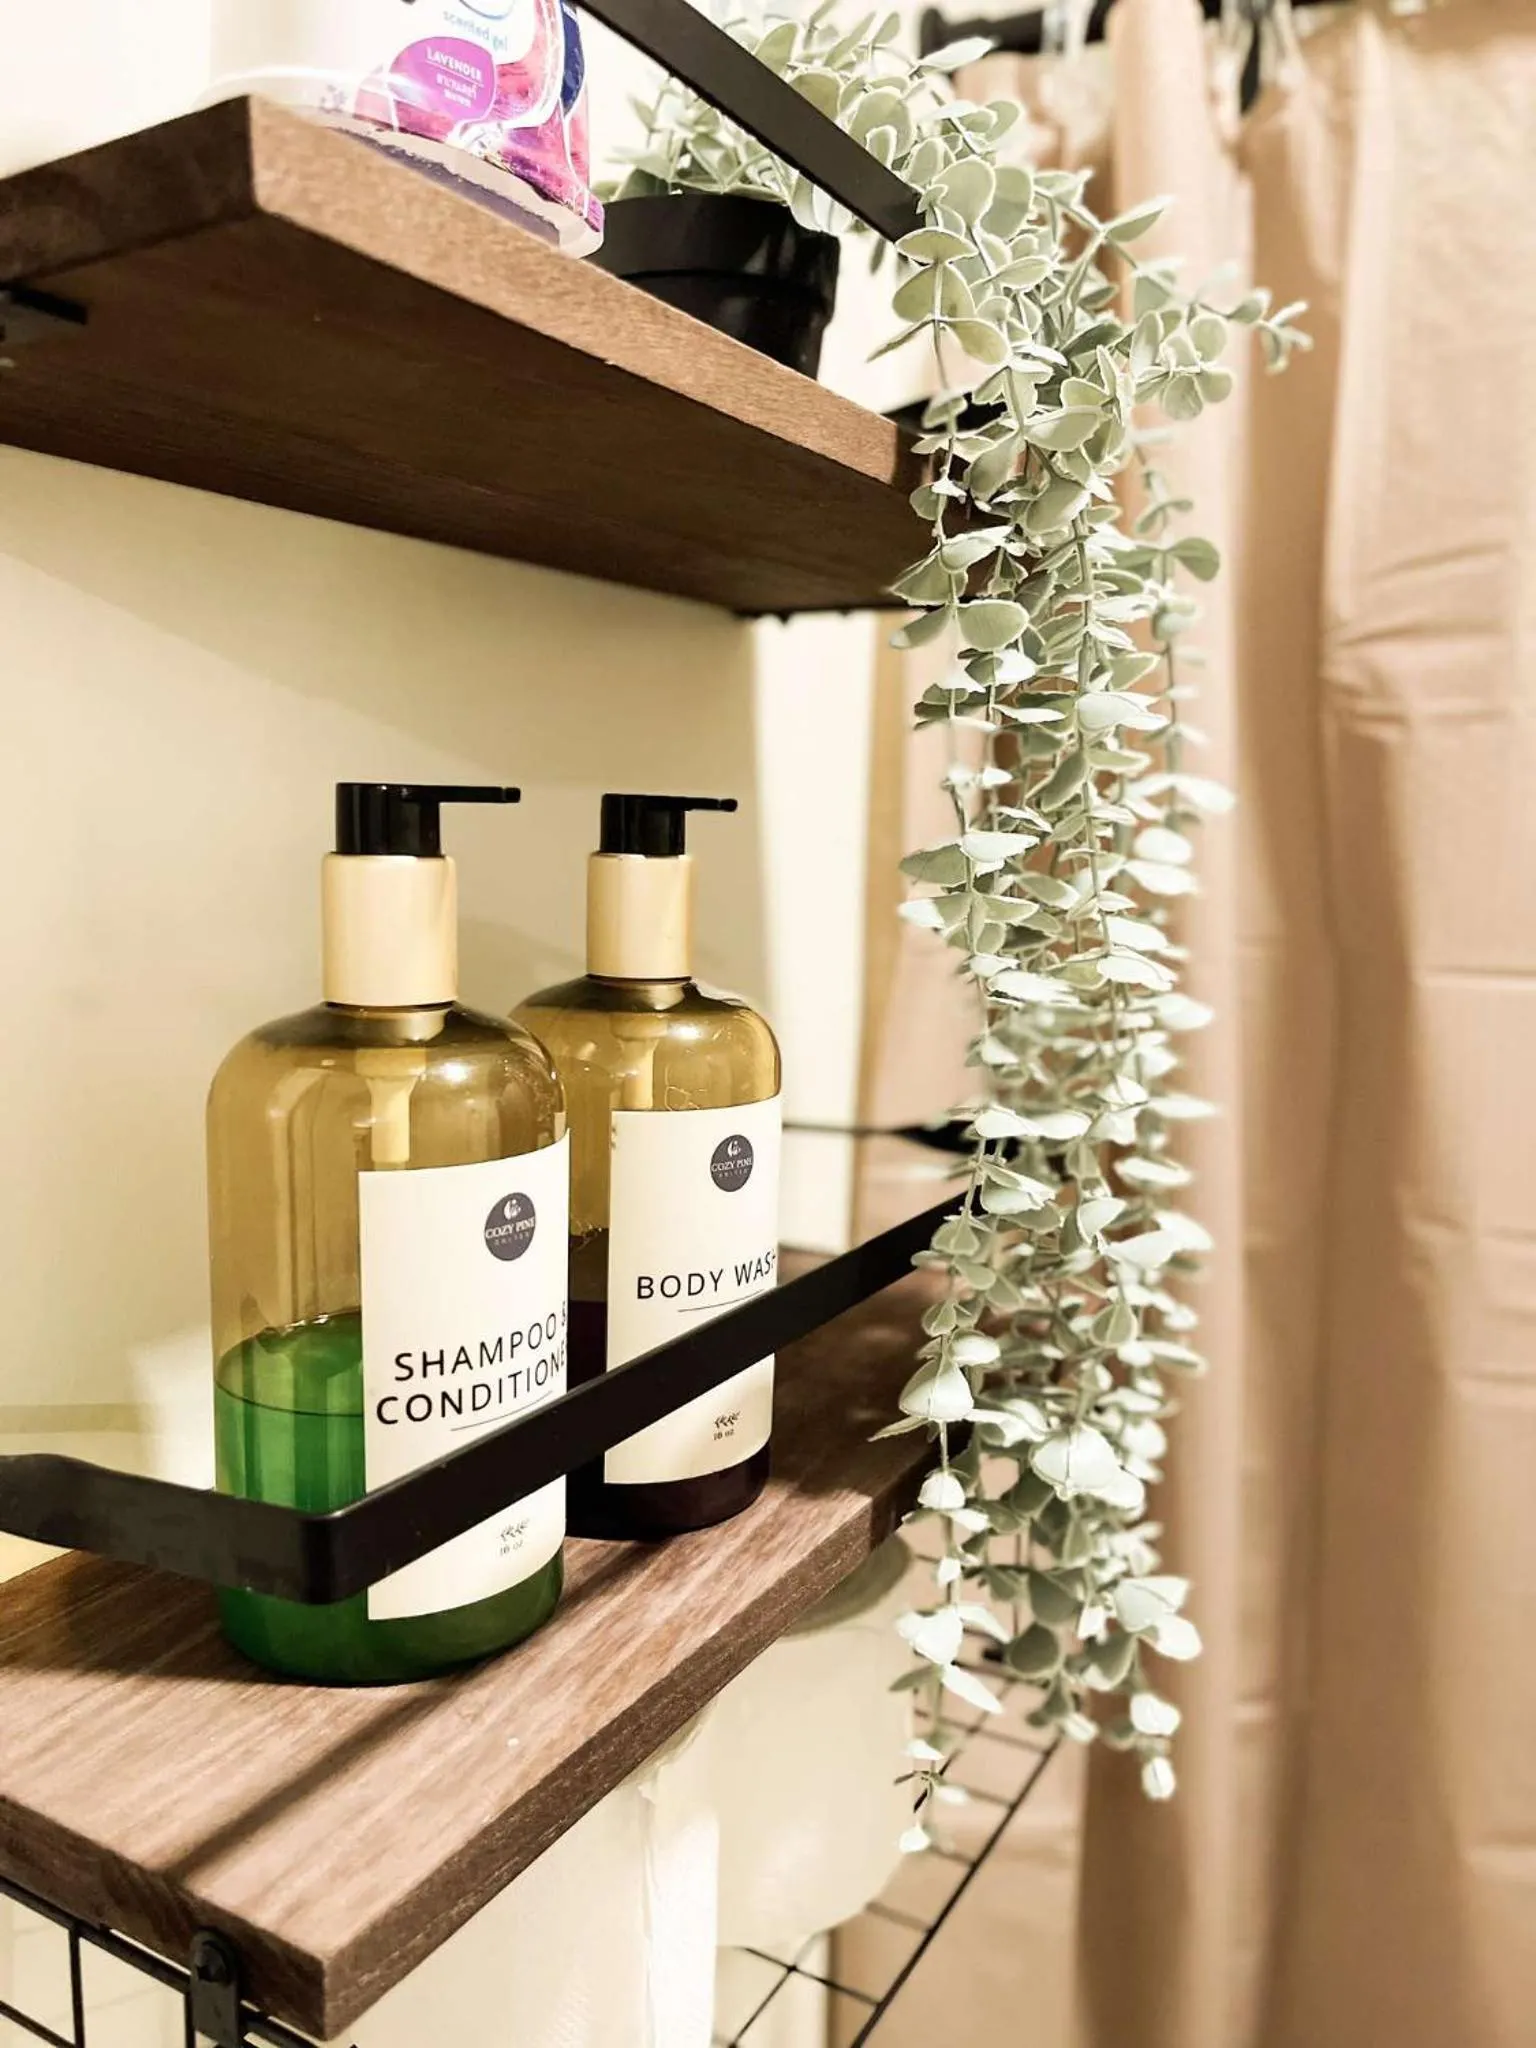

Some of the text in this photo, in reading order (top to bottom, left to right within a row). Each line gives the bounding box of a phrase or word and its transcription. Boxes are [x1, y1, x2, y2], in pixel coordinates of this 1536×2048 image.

[426, 46, 482, 81] LAVENDER
[711, 1161, 735, 1172] COZY
[485, 1223, 515, 1239] COZY
[636, 1268, 724, 1300] BODY
[394, 1312, 557, 1382] SHAMPOO
